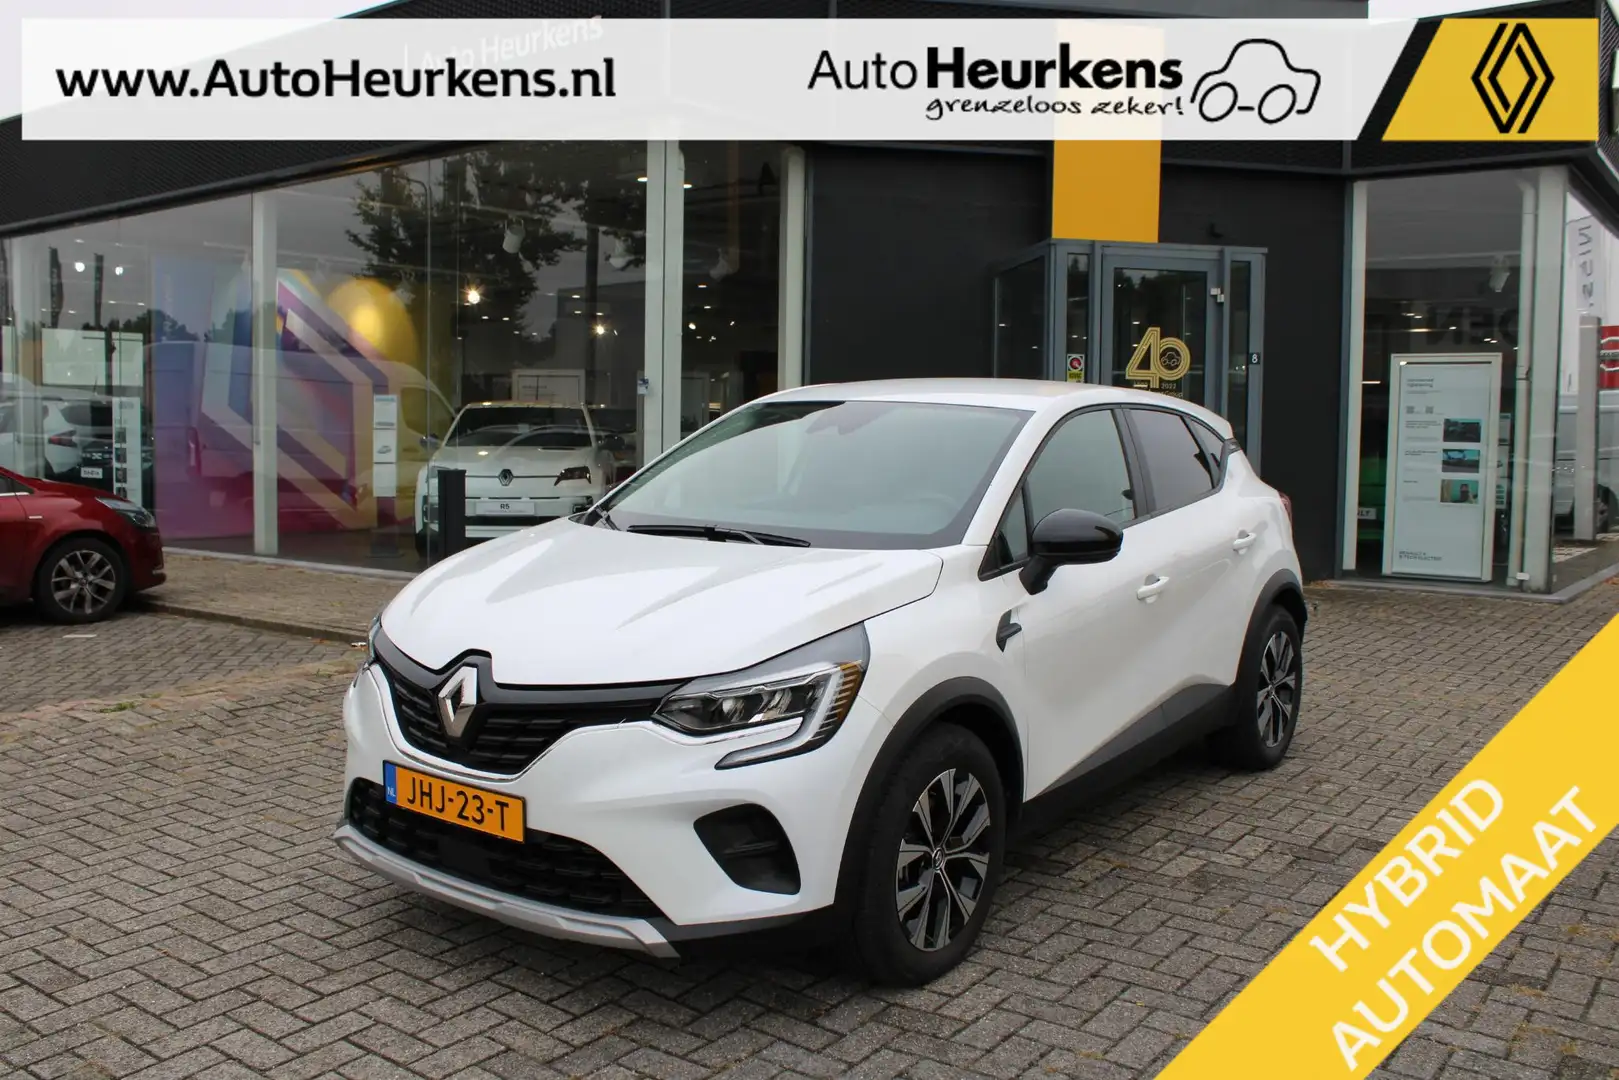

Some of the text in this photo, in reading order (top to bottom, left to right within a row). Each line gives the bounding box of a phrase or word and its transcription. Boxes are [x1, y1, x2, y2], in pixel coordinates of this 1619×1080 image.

[479, 15, 605, 64] Heurkens
[1252, 354, 1258, 363] 8
[387, 787, 396, 797] NL
[407, 777, 509, 831] JHJ-23-T
